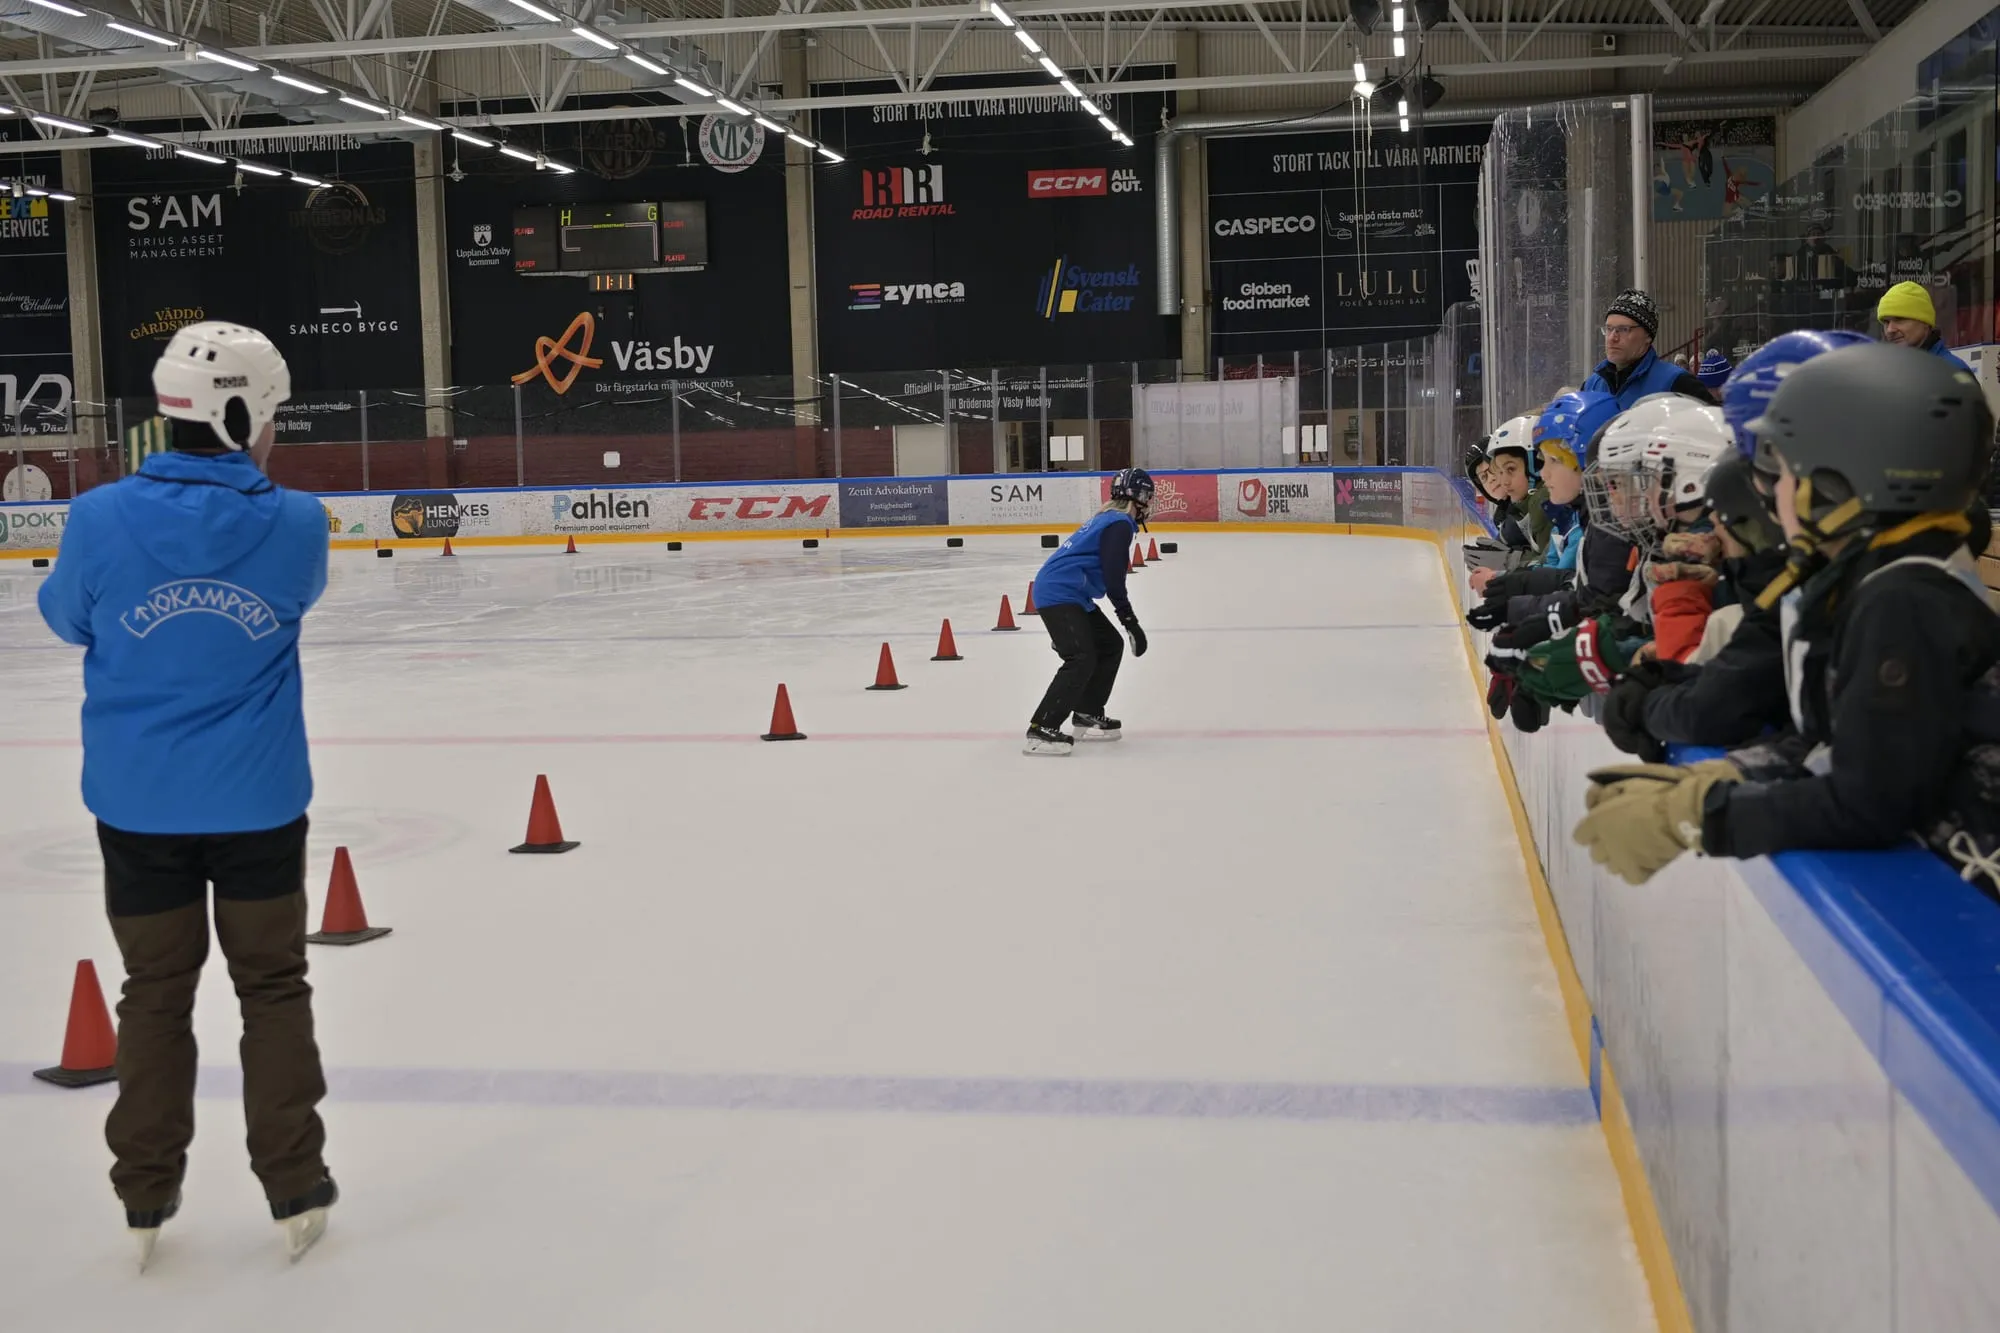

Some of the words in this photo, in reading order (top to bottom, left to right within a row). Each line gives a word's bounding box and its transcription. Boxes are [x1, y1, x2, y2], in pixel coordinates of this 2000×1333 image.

[873, 105, 909, 123] STORT
[914, 102, 943, 120] TACK
[947, 100, 972, 118] TILL
[714, 122, 751, 159] VIK
[1272, 153, 1313, 174] STORT
[1317, 151, 1350, 171] TACK
[1354, 150, 1382, 169] TILL
[1385, 144, 1419, 167] VÅRA
[1032, 174, 1103, 191] CCM
[1111, 169, 1136, 181] ALL
[1111, 180, 1143, 193] OUT.
[561, 209, 572, 226] H
[647, 206, 657, 221] G
[852, 208, 894, 220] ROAD
[898, 204, 957, 217] RENTAL
[1339, 211, 1364, 224] Sugen
[1365, 211, 1376, 223] på
[1377, 210, 1401, 220] nästa
[1402, 208, 1424, 219] mål?
[1214, 215, 1315, 236] CASPECO
[129, 236, 174, 247] SIRIUS
[182, 234, 224, 245] ASSET
[130, 246, 224, 259] MANAGEMENT
[456, 249, 488, 260] Upplands
[490, 247, 511, 258] Väsby
[664, 254, 685, 262] PLAYER
[468, 258, 500, 267] kommun
[515, 260, 536, 268] PLAYER
[1066, 263, 1140, 288] Svensk
[1336, 268, 1428, 297] LULU
[884, 281, 965, 305] zynca
[1240, 282, 1292, 296] Globen
[1077, 290, 1135, 313] Cater
[1222, 296, 1255, 311] food
[1256, 294, 1311, 309] market
[155, 307, 205, 321] VÄDDÖ
[130, 320, 197, 340] GÅRDSM
[289, 322, 353, 335] SANECO
[358, 320, 400, 333] BYGG
[611, 336, 715, 374] Väsby
[596, 382, 610, 393] Där
[613, 381, 660, 395] färgstarka
[711, 379, 735, 390] möts
[904, 382, 933, 395] Officiell
[934, 380, 969, 392] levrantör
[1002, 395, 1023, 408] Väsby
[2, 423, 38, 435] Väby
[288, 419, 313, 432] Hockey
[848, 486, 872, 496] Zenit
[875, 484, 933, 497] Advokatbyrå
[1268, 484, 1309, 498] SVENSKA
[1353, 478, 1368, 489] Uffe
[1369, 478, 1393, 492] Tryckare
[426, 503, 489, 519] HENKES
[551, 493, 649, 520] Pahlén
[688, 495, 831, 520] CCM
[1268, 499, 1290, 513] SPEL
[554, 524, 588, 532] Premium
[590, 523, 607, 532] pool
[609, 522, 650, 532] equipment
